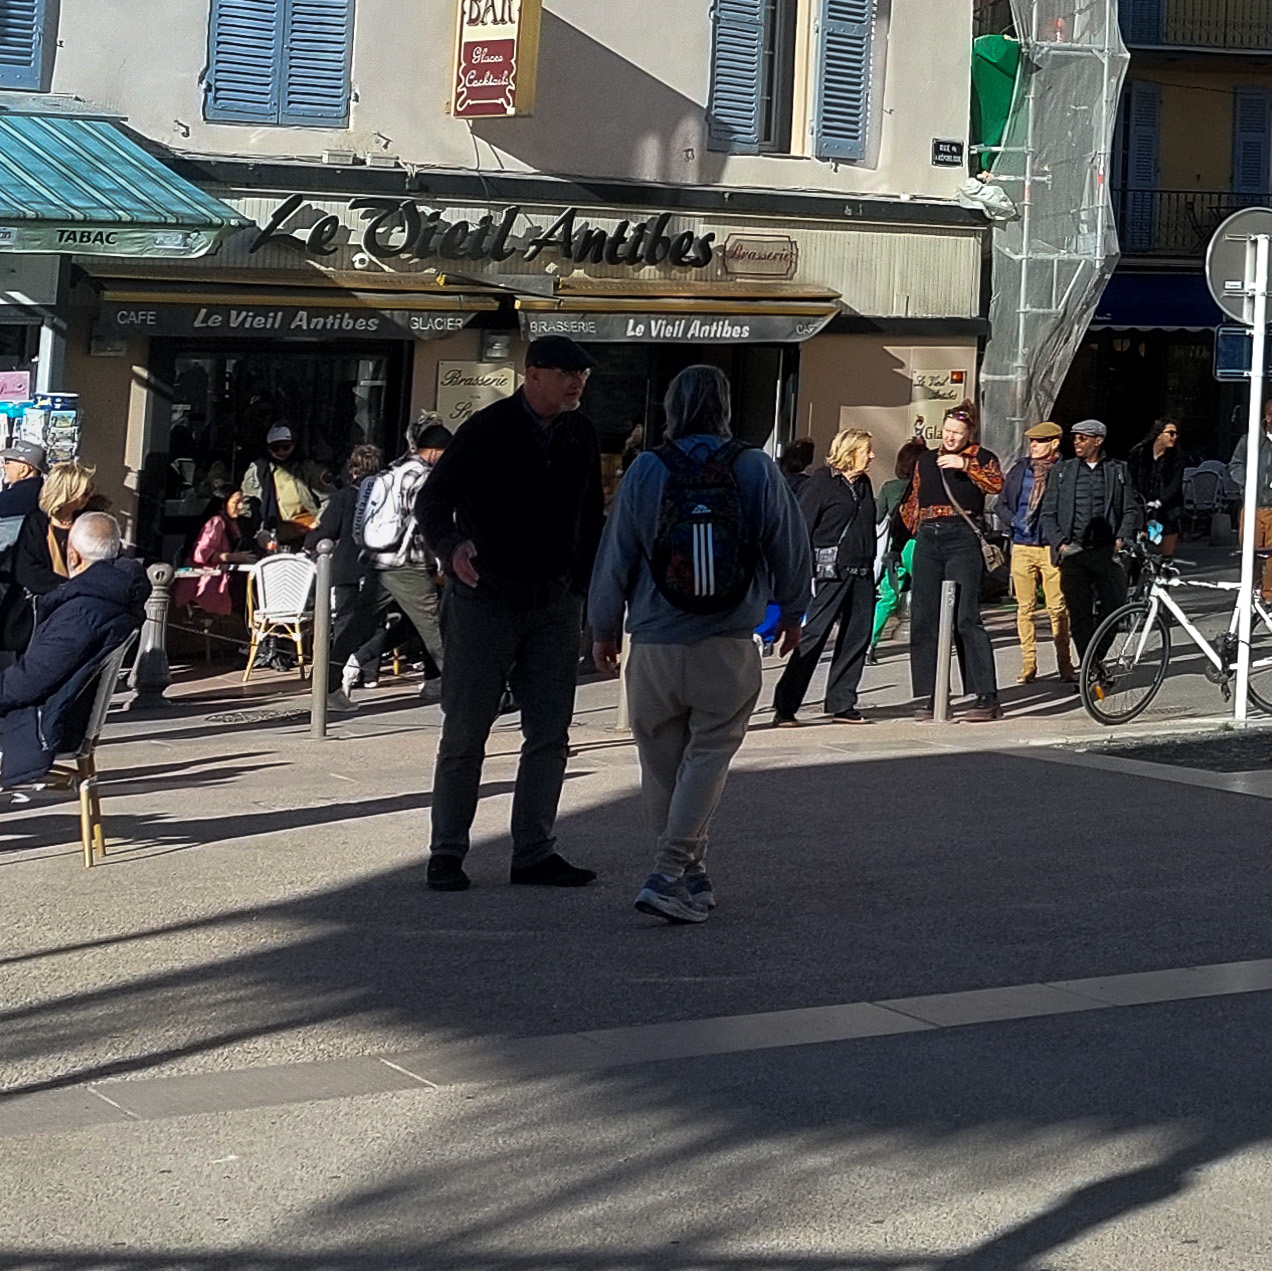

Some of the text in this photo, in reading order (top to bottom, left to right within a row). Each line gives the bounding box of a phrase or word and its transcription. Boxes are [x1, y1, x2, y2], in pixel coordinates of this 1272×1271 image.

[56, 229, 118, 246] TABAC
[249, 193, 717, 268] Le Vieil Antibes
[117, 308, 464, 331] CAFE Le Vieil Antibes GLACIER
[529, 320, 596, 334] BRASSERIE
[626, 319, 643, 337] Le
[650, 319, 681, 338] Vieil
[686, 320, 750, 339] Antibes
[441, 369, 509, 387] Brasserie
